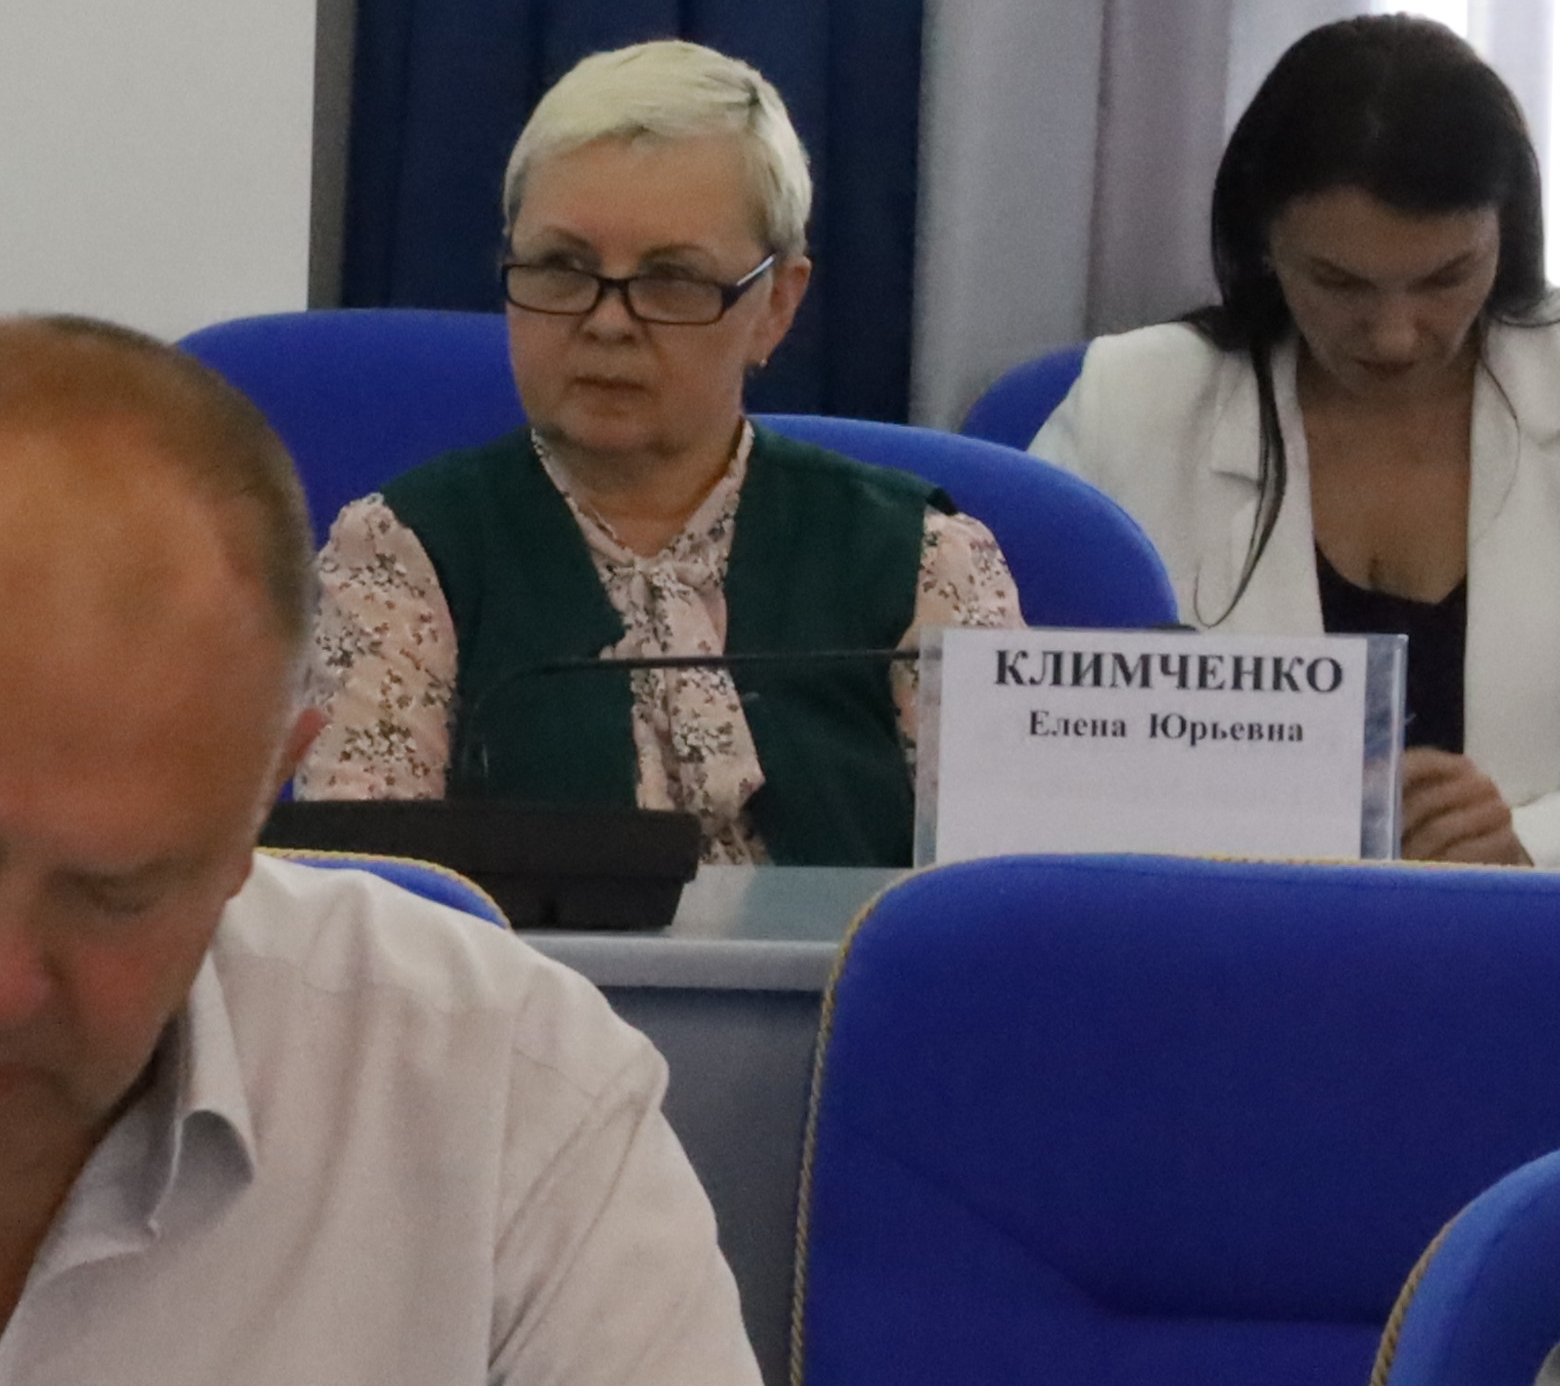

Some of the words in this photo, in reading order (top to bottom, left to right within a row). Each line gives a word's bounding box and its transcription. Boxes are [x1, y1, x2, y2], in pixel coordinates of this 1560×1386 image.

[995, 649, 1343, 693] КЛИМЧЕНКО
[1029, 710, 1127, 738] Елена
[1149, 713, 1303, 747] Юрьевна
